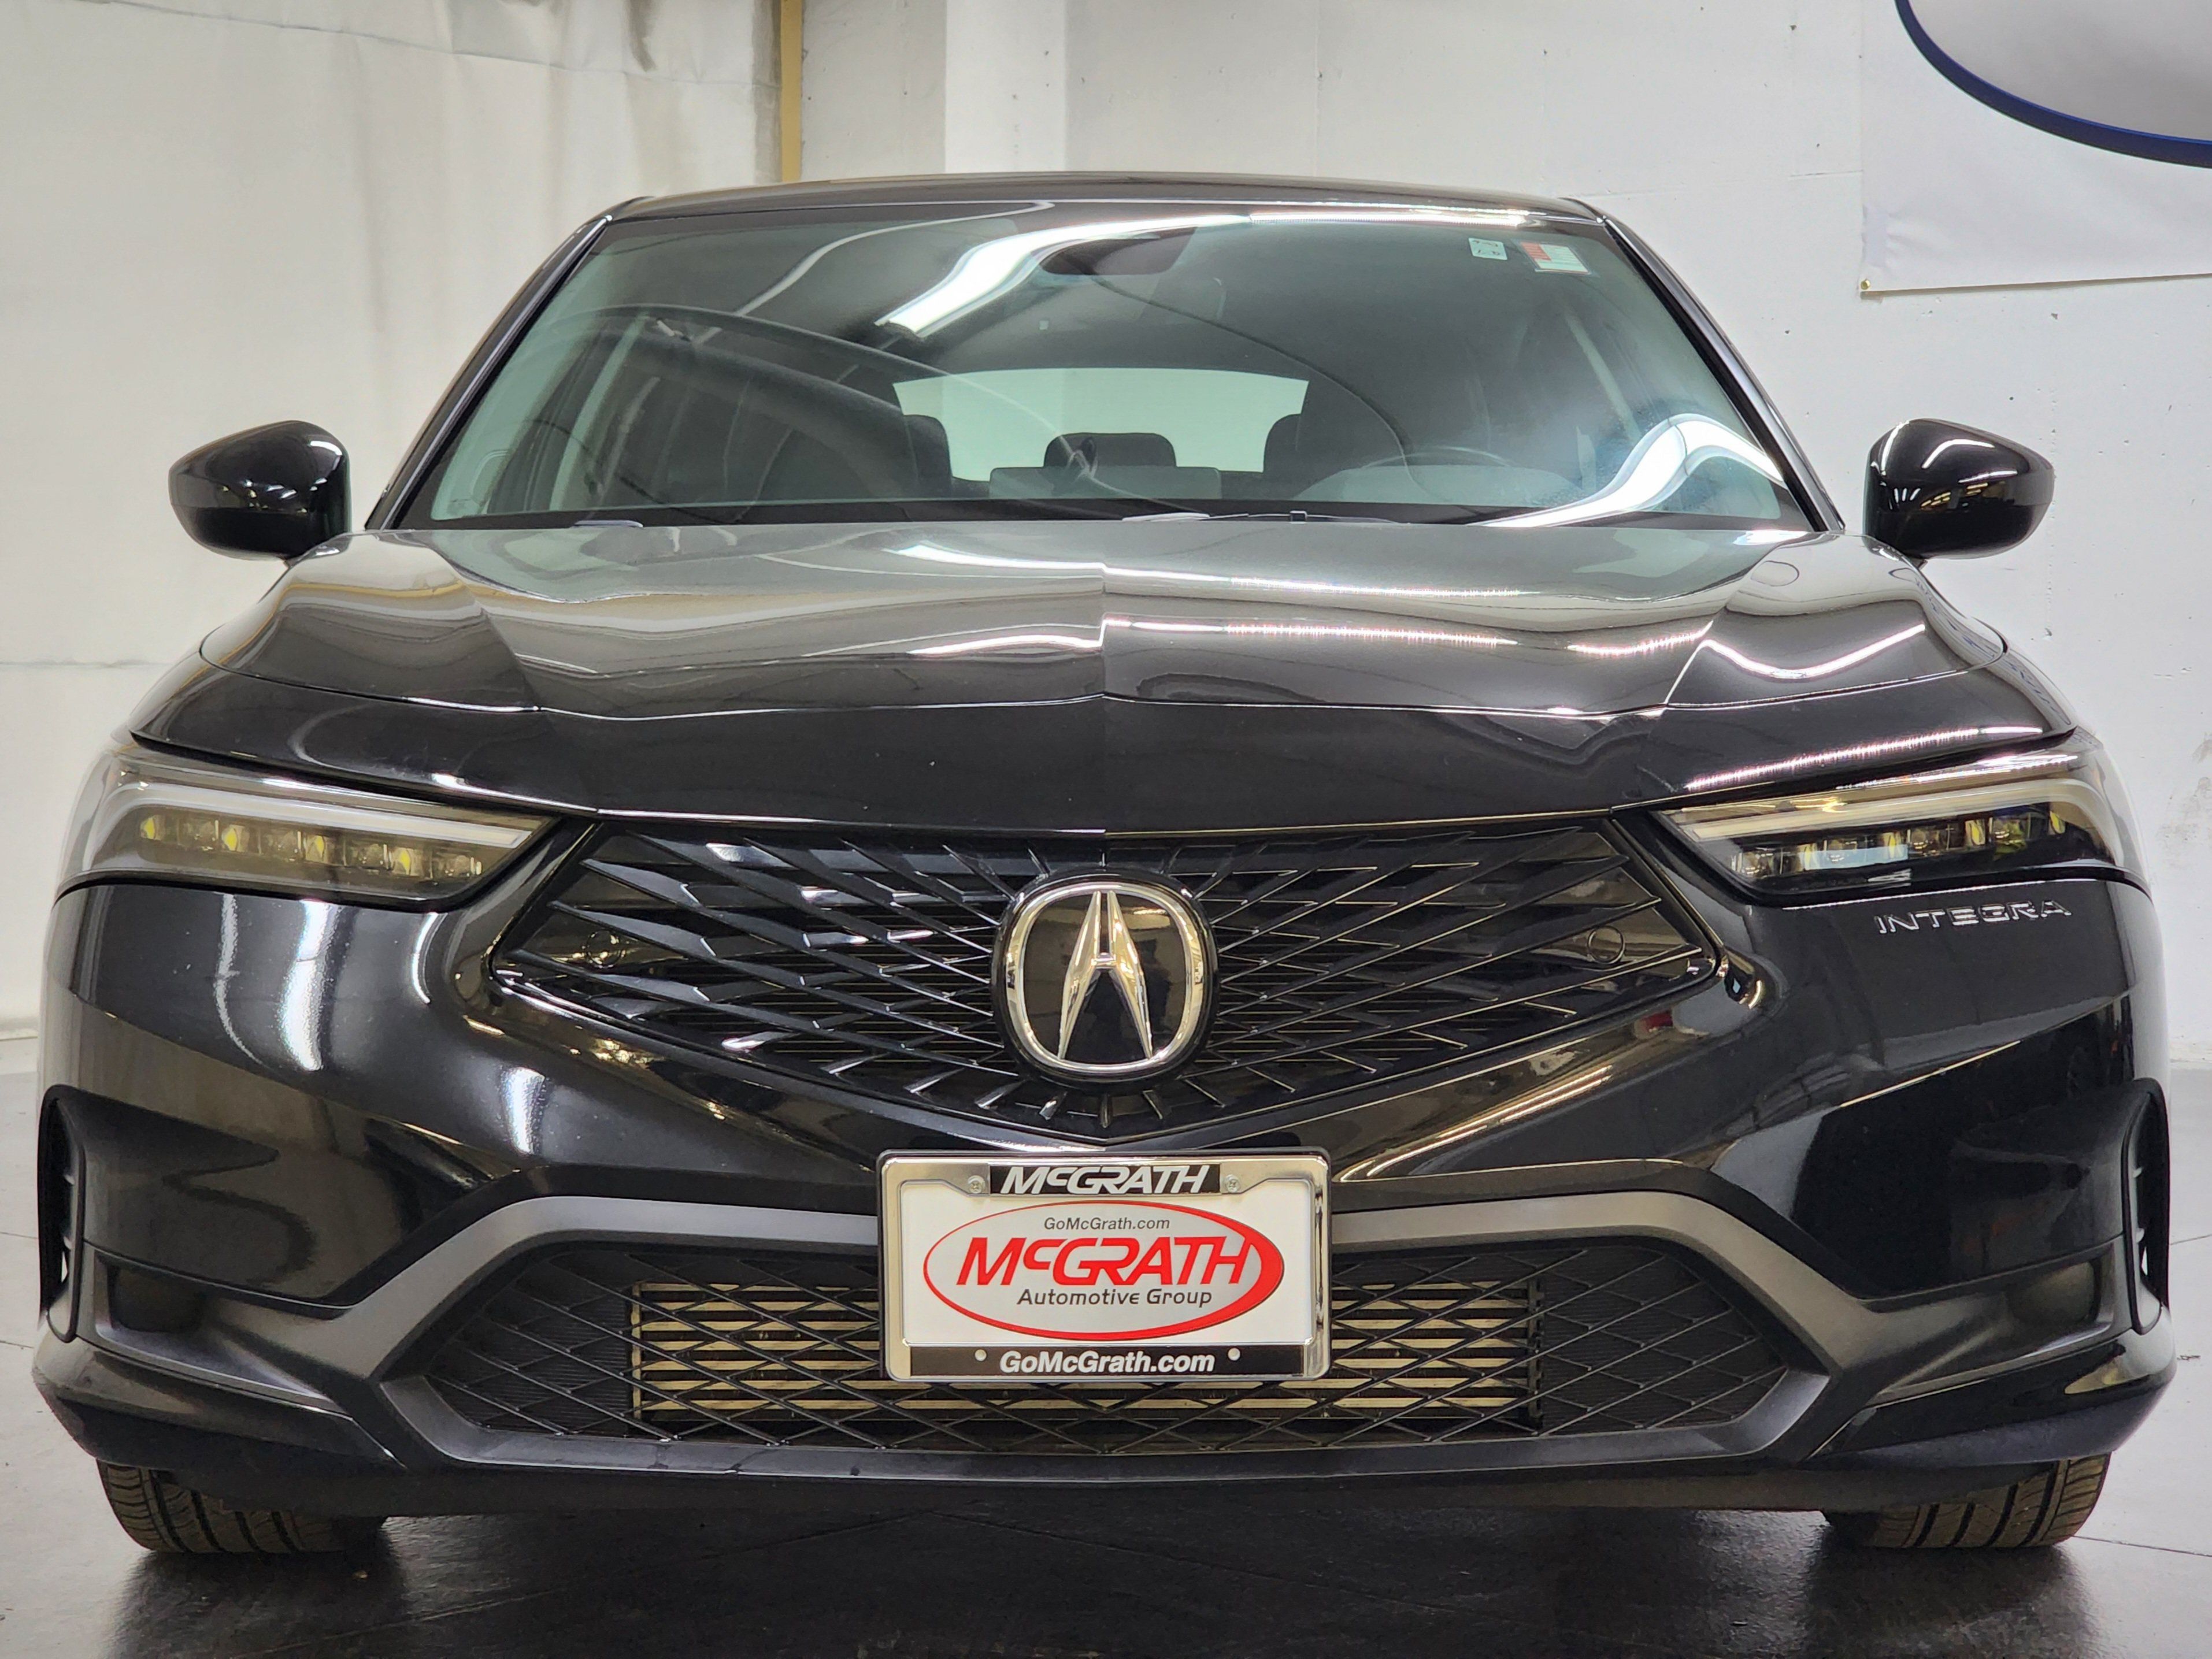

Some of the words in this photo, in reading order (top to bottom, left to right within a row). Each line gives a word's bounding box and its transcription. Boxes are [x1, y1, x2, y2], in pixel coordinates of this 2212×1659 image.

[1873, 900, 2072, 934] INTEGRA
[1044, 1216, 1170, 1230] GoMcGrath.com
[1017, 1288, 1140, 1305] Automotive
[1146, 1289, 1213, 1308] Group
[999, 1350, 1215, 1374] GoMcGrath.com
